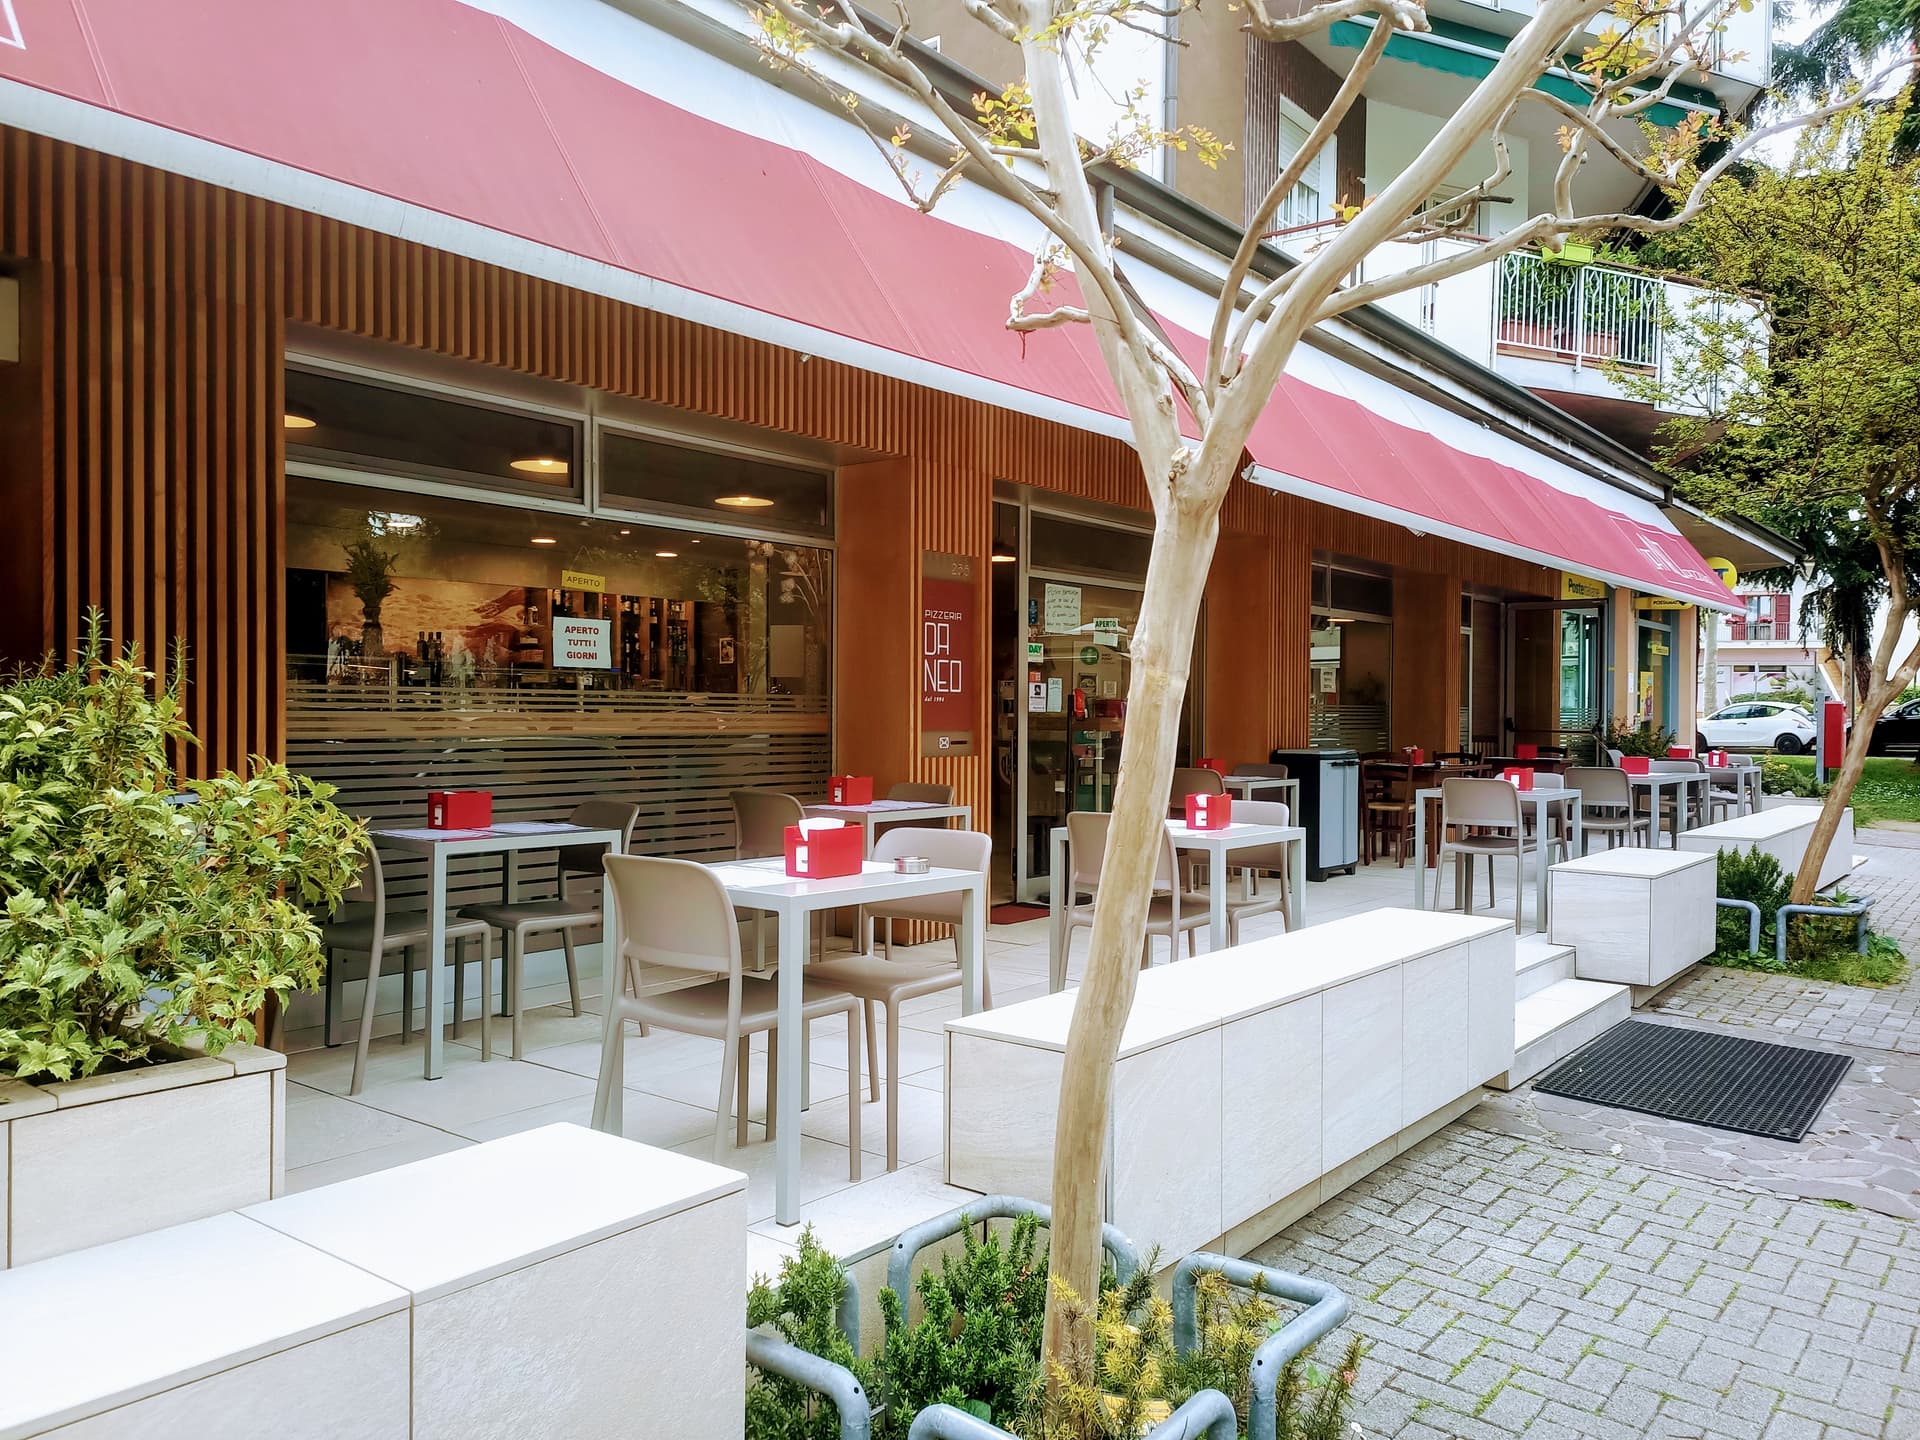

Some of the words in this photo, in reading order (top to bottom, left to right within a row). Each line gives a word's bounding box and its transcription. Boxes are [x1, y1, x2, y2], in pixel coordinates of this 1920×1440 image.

[566, 575, 600, 588] APERTO
[924, 609, 962, 621] PIZZERIA
[1094, 620, 1117, 628] APERTO
[564, 625, 600, 635] APERTO
[567, 638, 592, 647] TUTTI
[593, 639, 597, 647] I
[924, 622, 950, 656] DA
[1028, 644, 1042, 654] DAY
[566, 651, 598, 660] GIORNI
[924, 659, 962, 693] NEO
